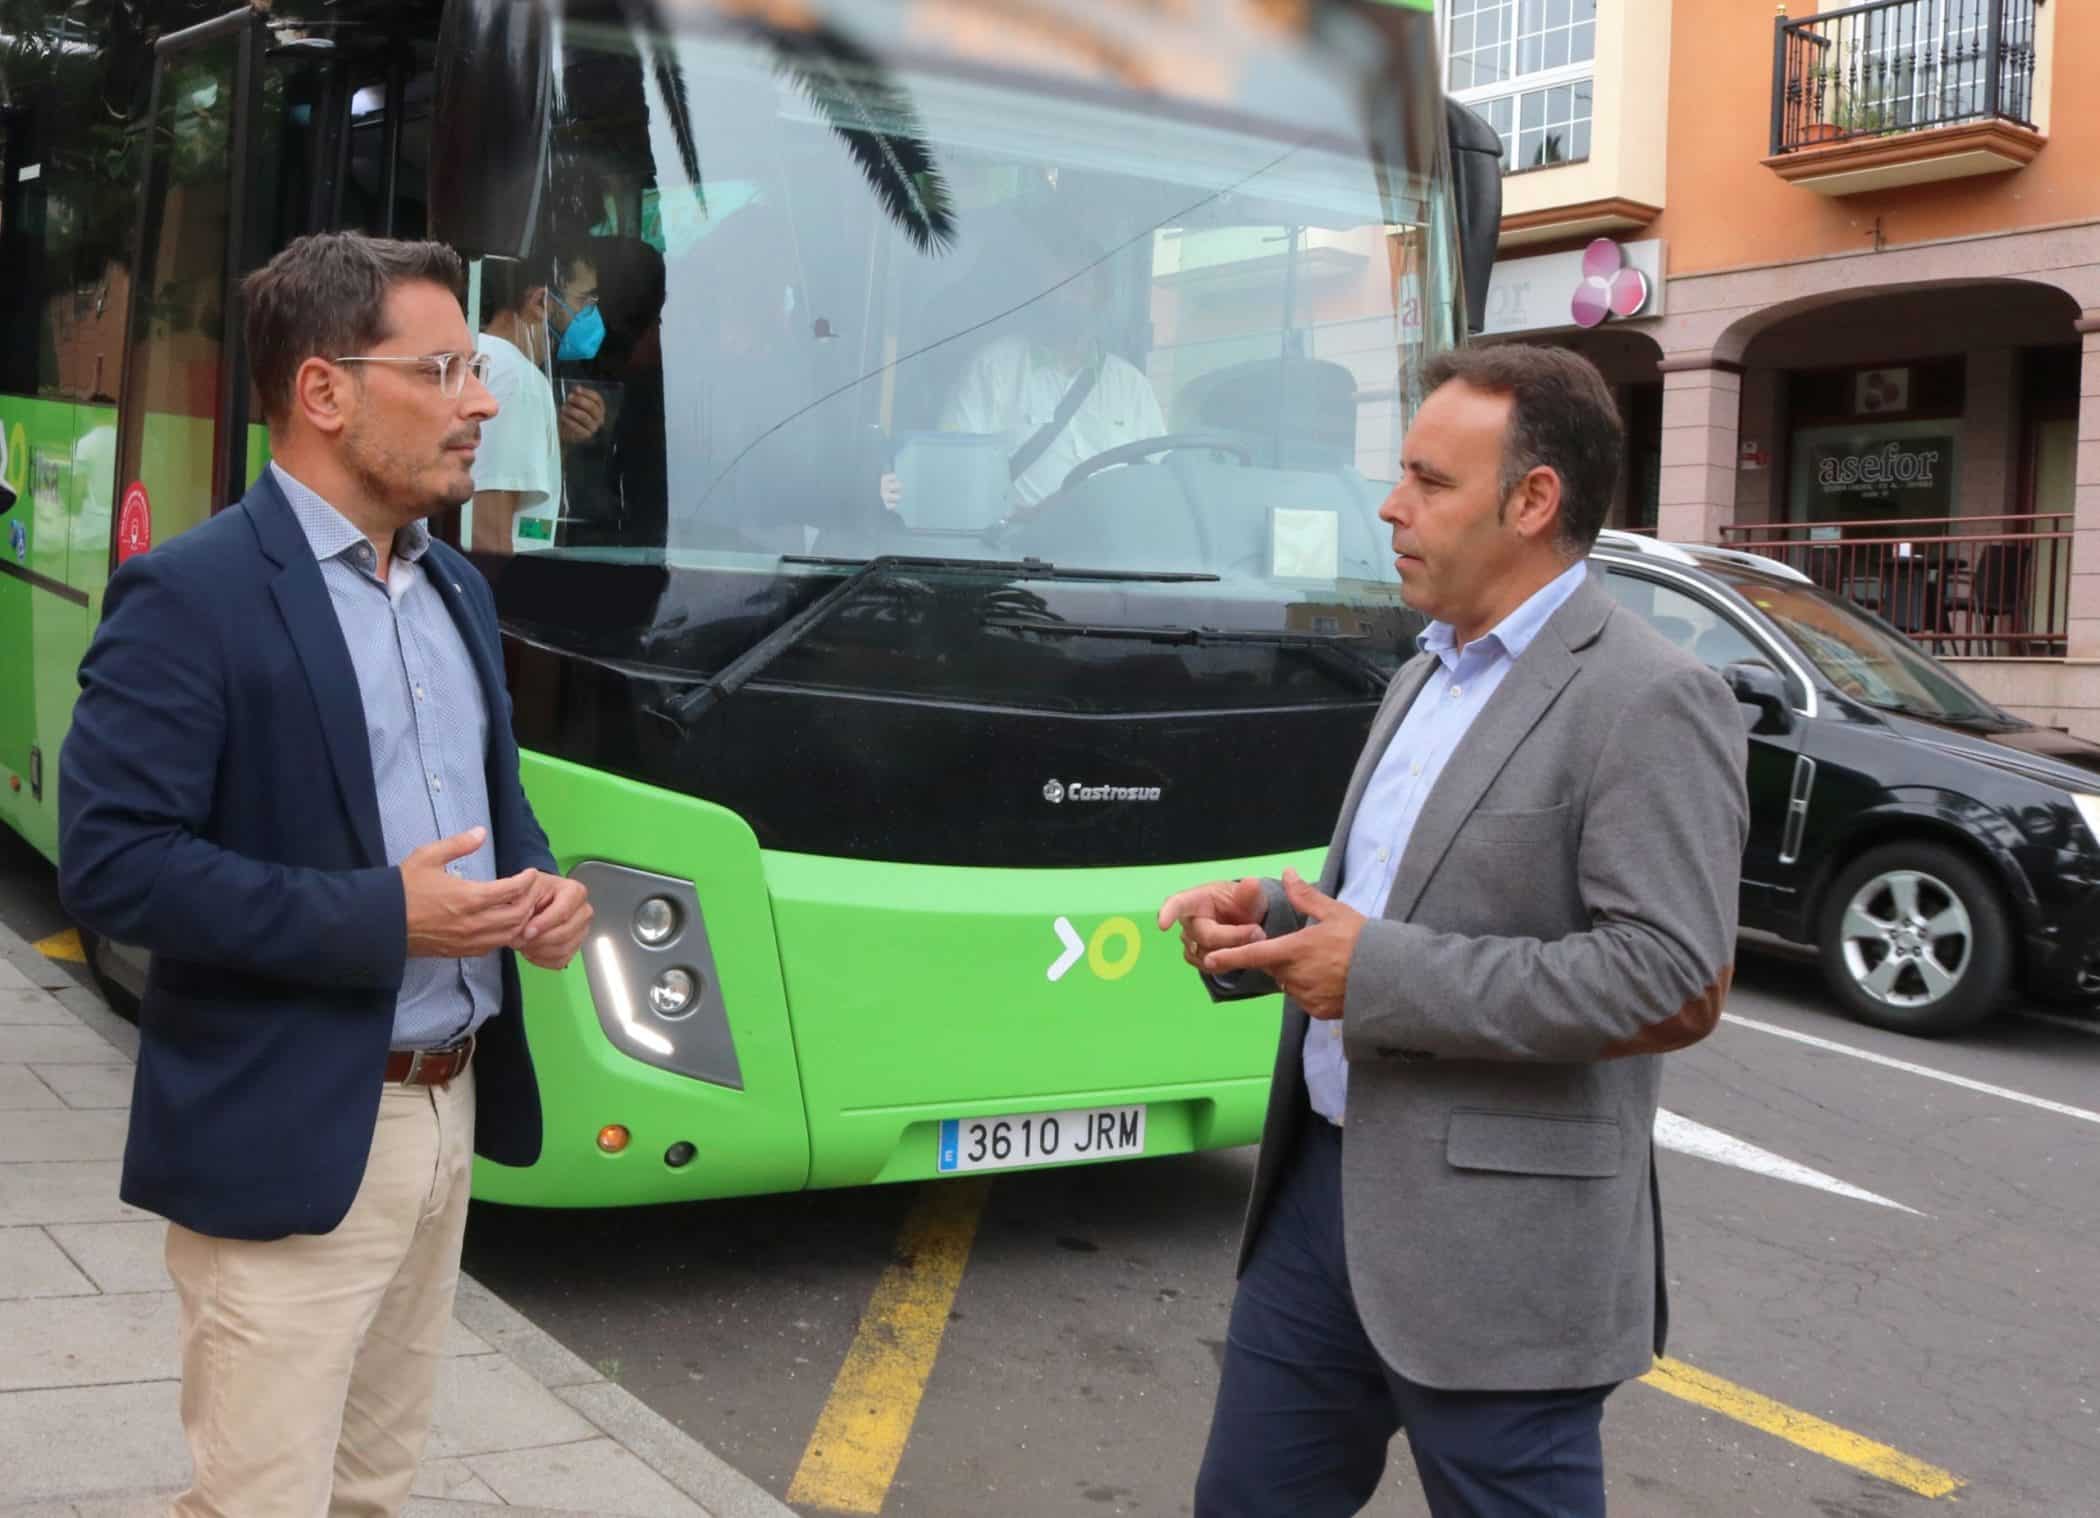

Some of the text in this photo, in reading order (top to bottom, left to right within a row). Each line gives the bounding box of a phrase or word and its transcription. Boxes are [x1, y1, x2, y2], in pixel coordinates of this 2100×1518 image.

[1818, 441, 1939, 486] asefor
[1068, 782, 1161, 801] Castrosua
[967, 1117, 1060, 1162] 3610
[1074, 1109, 1139, 1152] JRM
